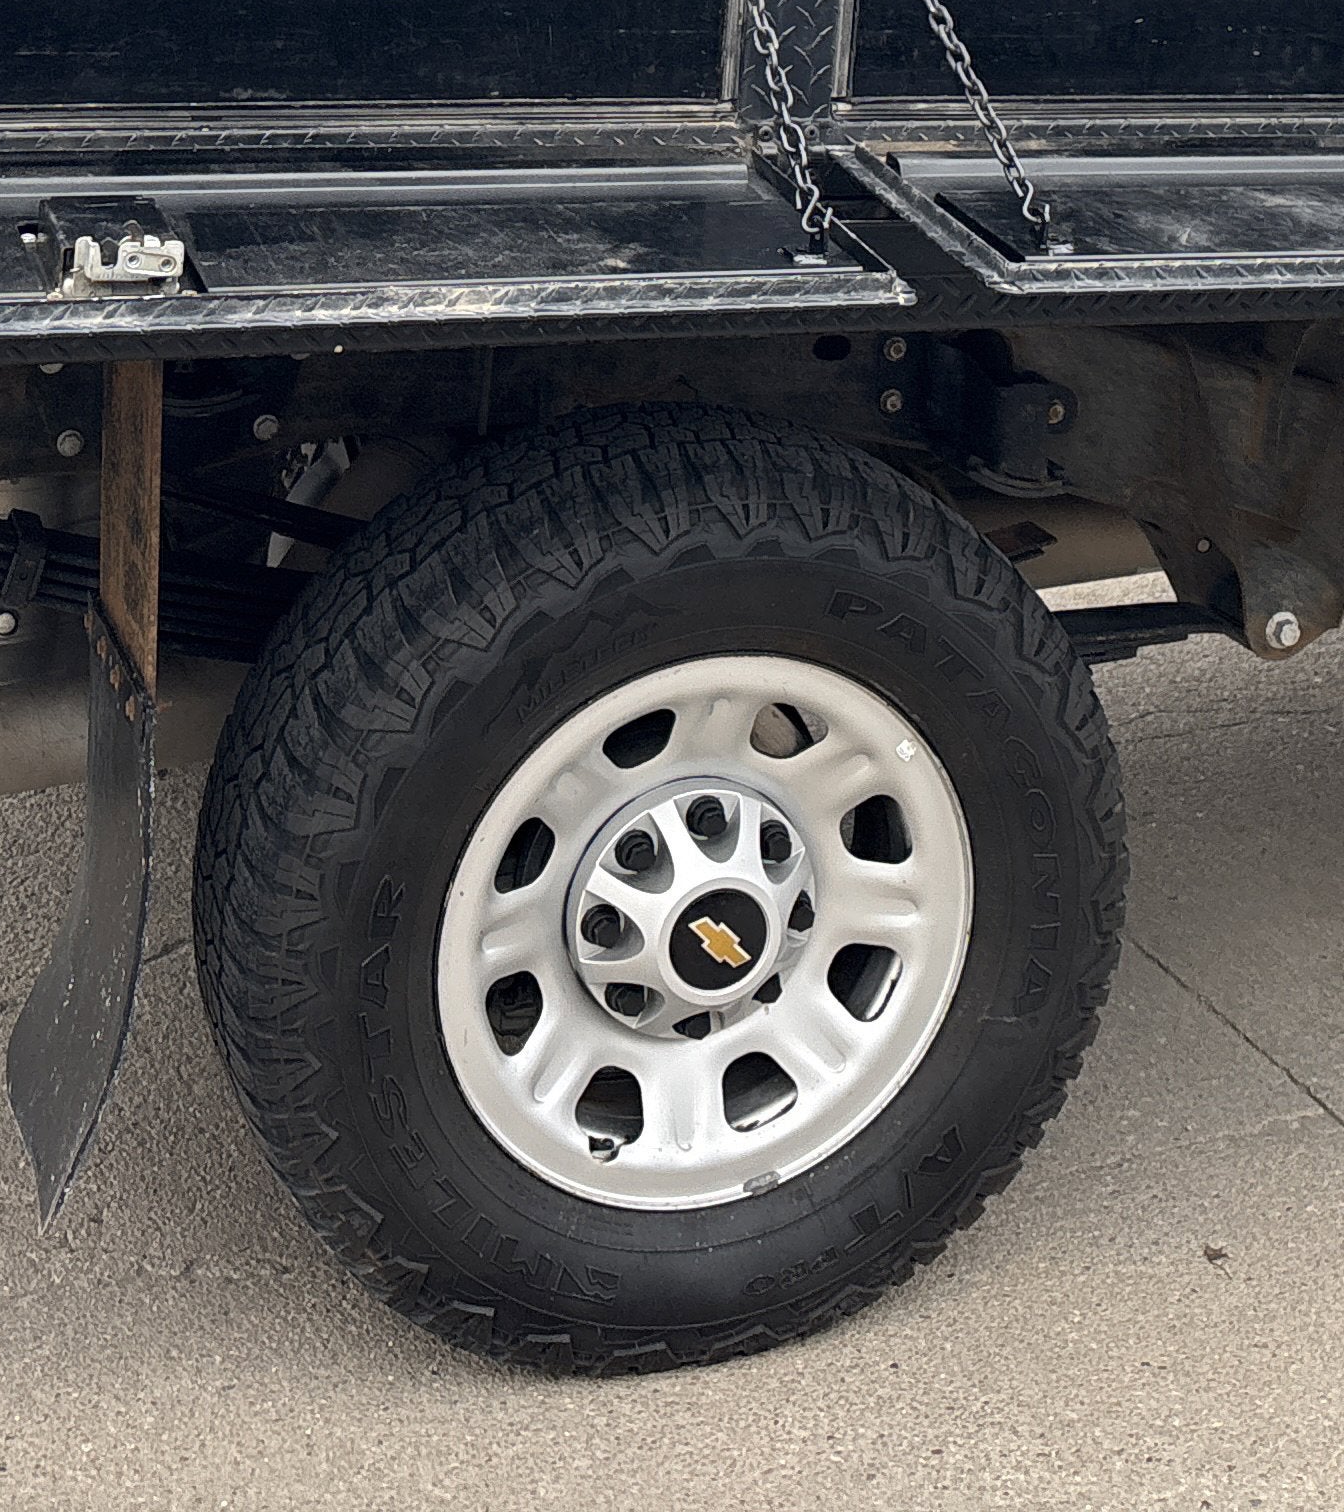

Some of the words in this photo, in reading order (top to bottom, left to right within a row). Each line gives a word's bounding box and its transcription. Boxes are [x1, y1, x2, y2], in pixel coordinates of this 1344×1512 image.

[824, 589, 1061, 1015] PATAGONIA
[358, 874, 553, 1292] MILESTAR
[843, 1124, 967, 1257] A/T
[743, 1246, 840, 1296] PRO
